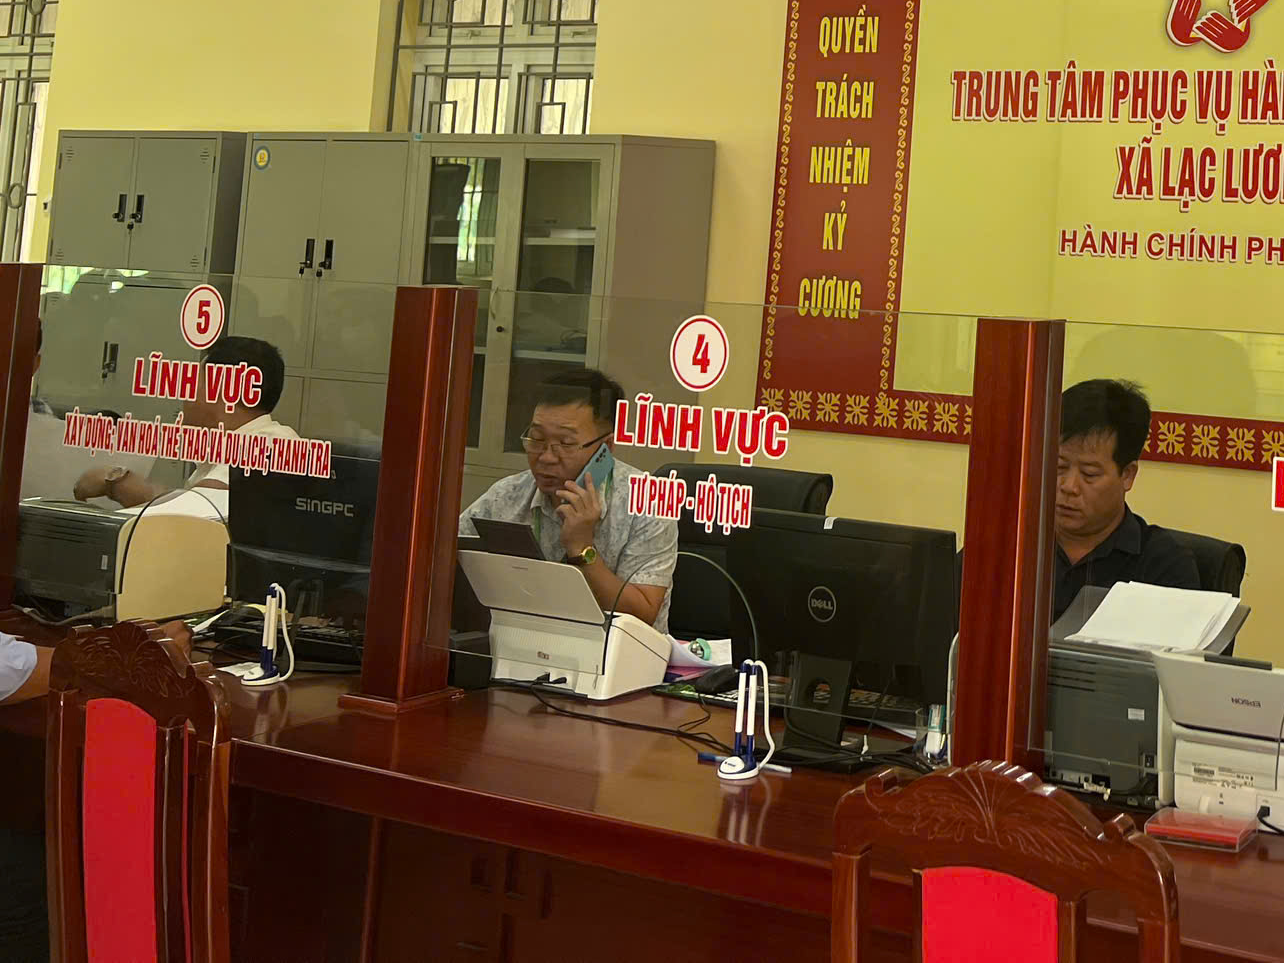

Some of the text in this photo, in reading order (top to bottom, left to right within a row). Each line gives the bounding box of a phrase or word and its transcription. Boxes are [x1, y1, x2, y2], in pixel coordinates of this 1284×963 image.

[819, 5, 879, 57] QUYỀN
[816, 74, 874, 118] TRÁCH
[950, 68, 1040, 122] TRUNG
[1045, 60, 1104, 123] TÂM
[1111, 69, 1188, 133] PHỤC
[1195, 69, 1232, 134] VỤ
[809, 139, 870, 192] NHIỆM
[1113, 136, 1155, 198] XÃ
[1160, 145, 1217, 212] LẠC
[822, 200, 847, 251] KỶ
[1059, 224, 1139, 259] HÀNH
[1145, 228, 1238, 263] CHÍNH
[195, 299, 212, 335] 5
[798, 274, 862, 319] CƯƠNG
[691, 333, 711, 374] 4
[132, 352, 263, 412] LĨNH VỰC
[64, 407, 332, 479] XÂY DỰNG; VĂN HOÁ THỂ THAO VÀ DU LỊCH; THANH TRA
[614, 392, 790, 467] LĨNH VỰC
[628, 472, 649, 516] TƯ
[648, 470, 687, 521] PHÁP
[694, 474, 717, 534] HỘ
[717, 484, 752, 535] TỊCH
[811, 597, 833, 611] DELL
